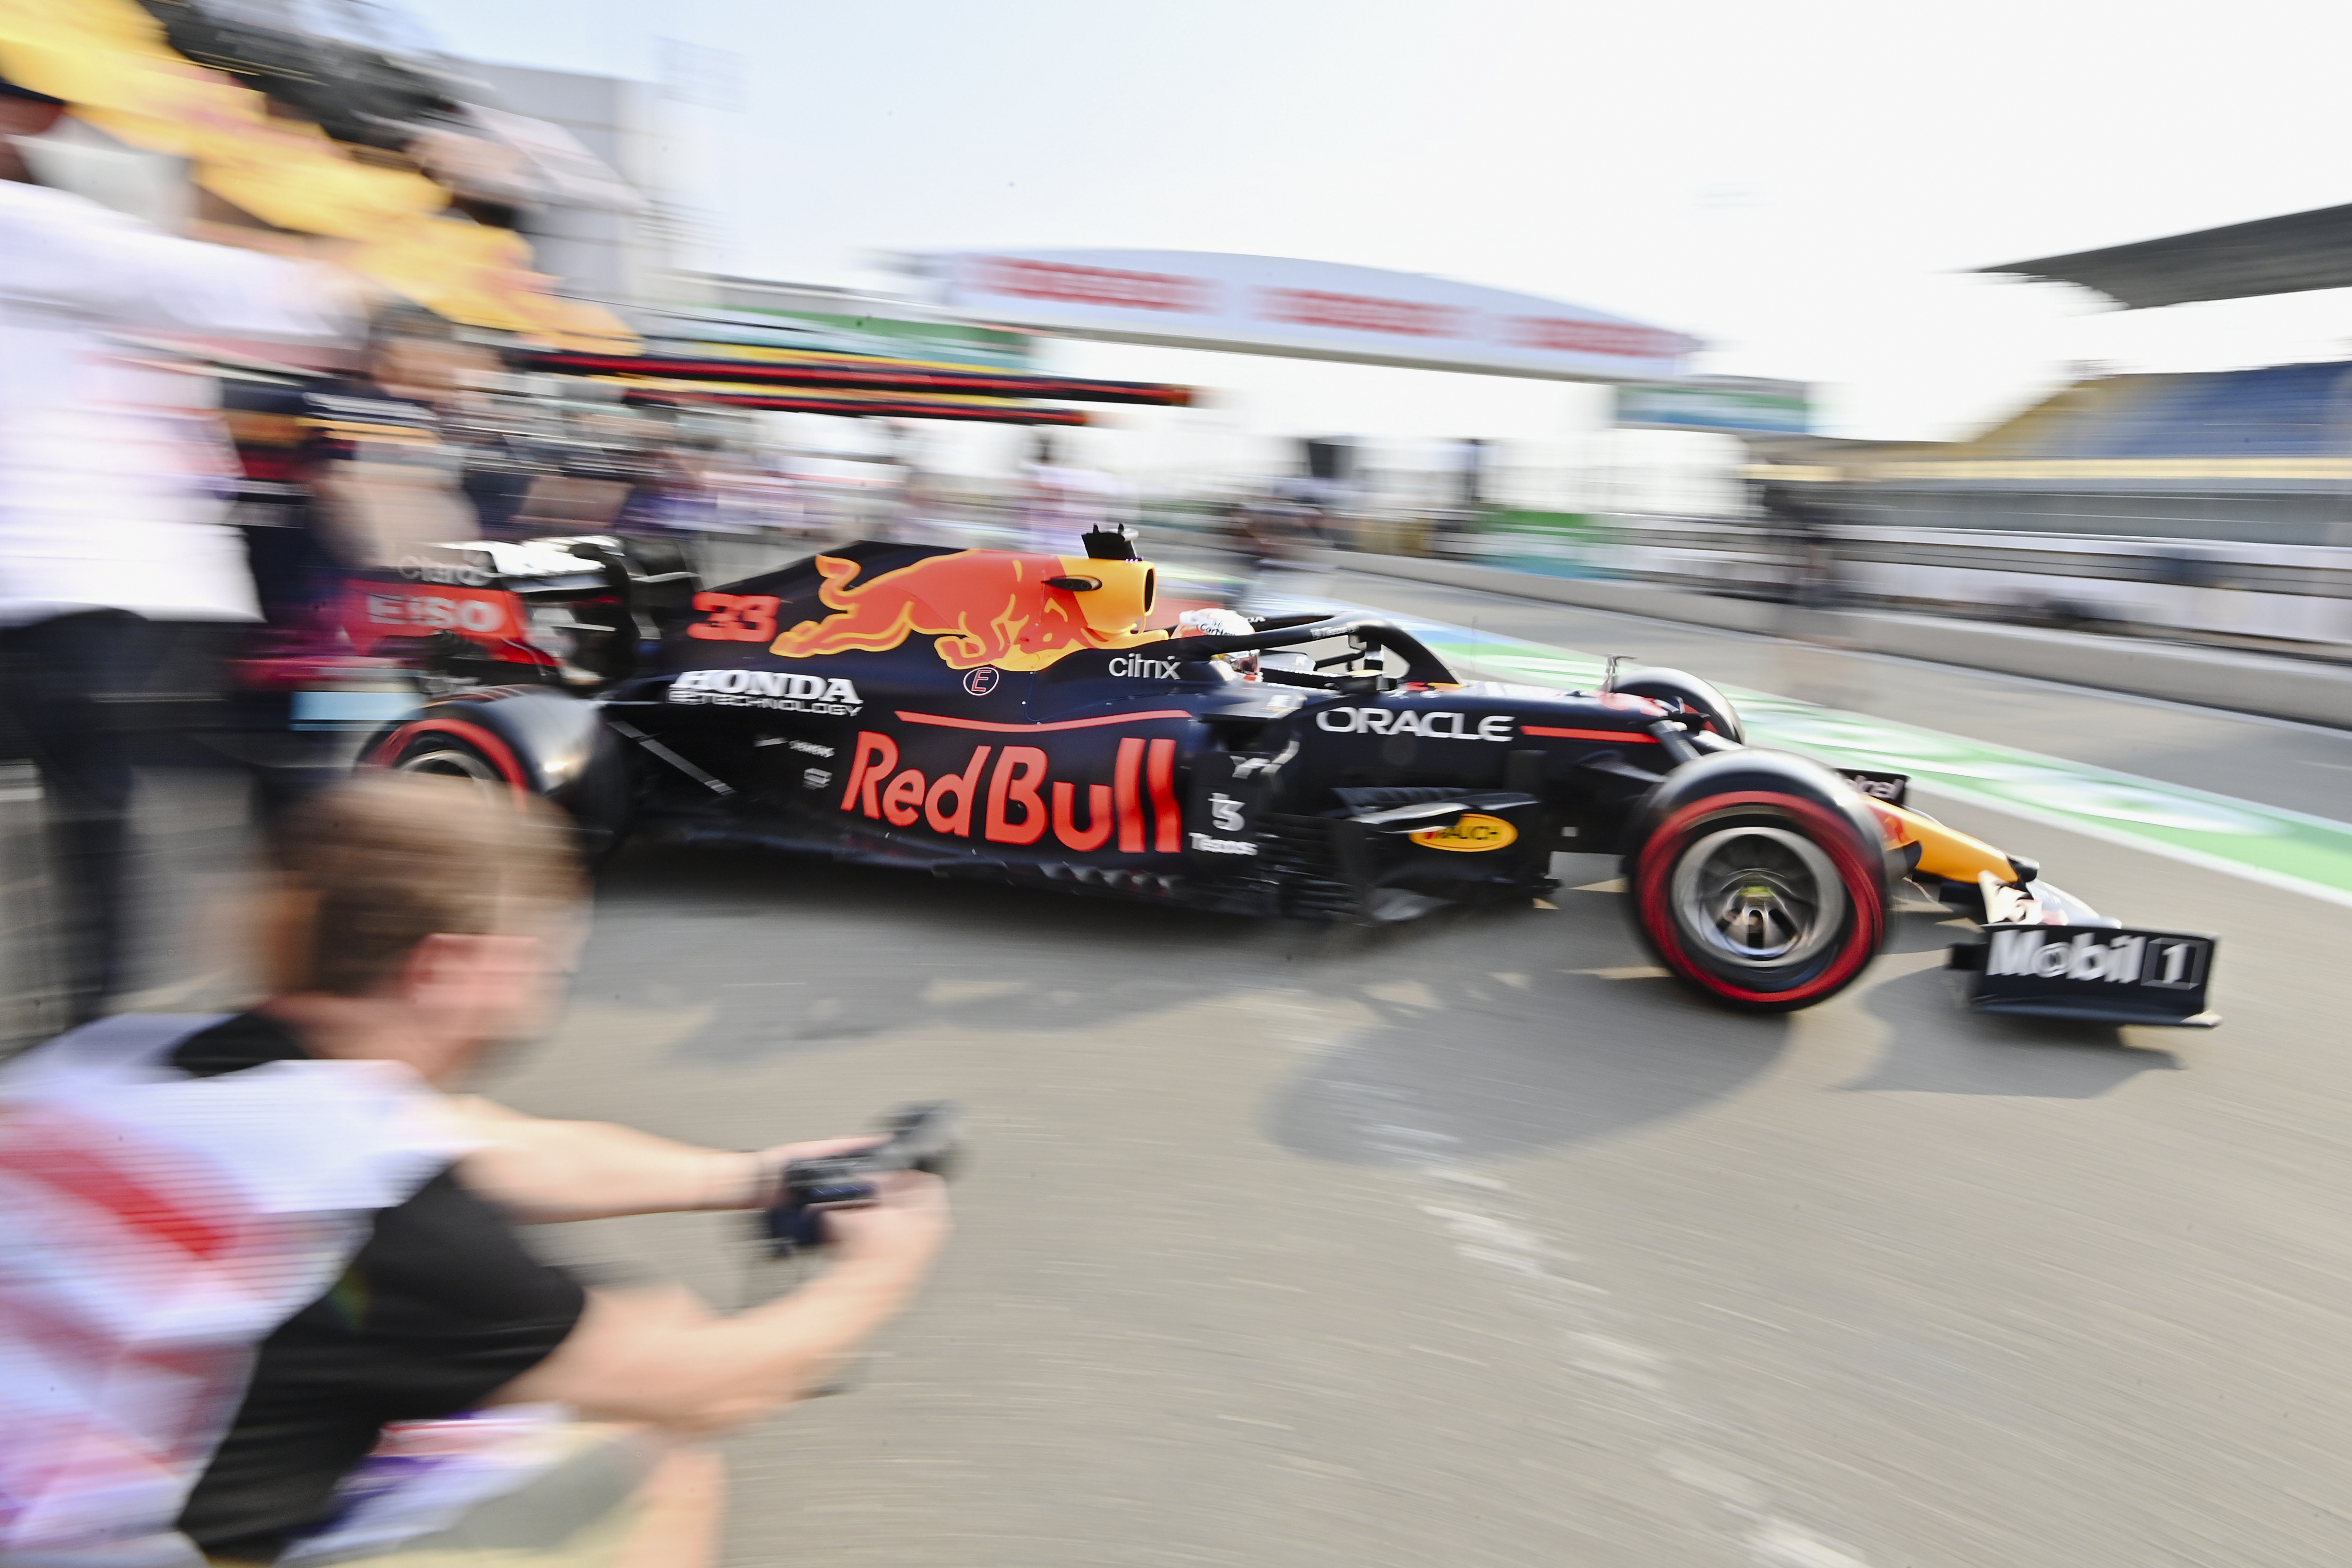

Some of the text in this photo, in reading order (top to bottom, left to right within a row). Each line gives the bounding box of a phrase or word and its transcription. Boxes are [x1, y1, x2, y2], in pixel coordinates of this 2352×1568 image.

[687, 592, 781, 642] 33
[669, 670, 864, 704] HONDA
[1109, 653, 1180, 680] citrix
[1316, 707, 1515, 742] ORACLE
[841, 731, 1182, 853] Red Bull
[1986, 929, 2188, 984] Mobil 1
